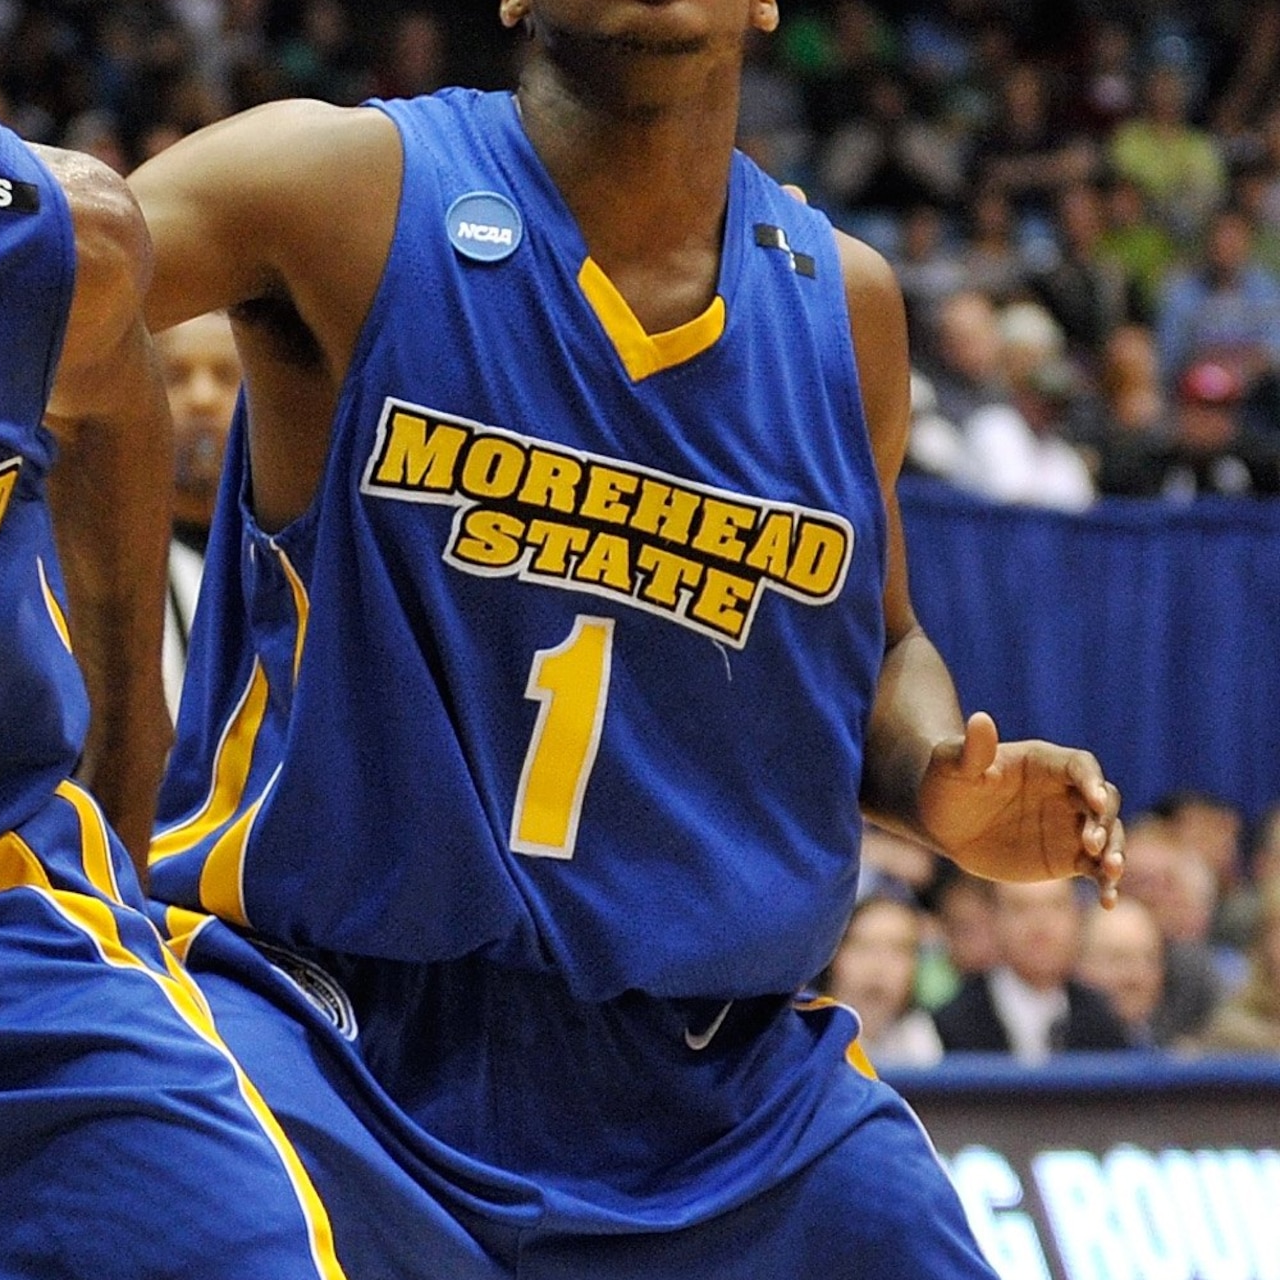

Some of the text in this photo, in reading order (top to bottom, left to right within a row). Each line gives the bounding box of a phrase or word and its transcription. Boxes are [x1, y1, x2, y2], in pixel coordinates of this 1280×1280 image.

[457, 221, 513, 246] NCAA
[370, 405, 852, 600] MOREHEAD
[450, 505, 761, 641] STATE
[508, 615, 616, 860] 1
